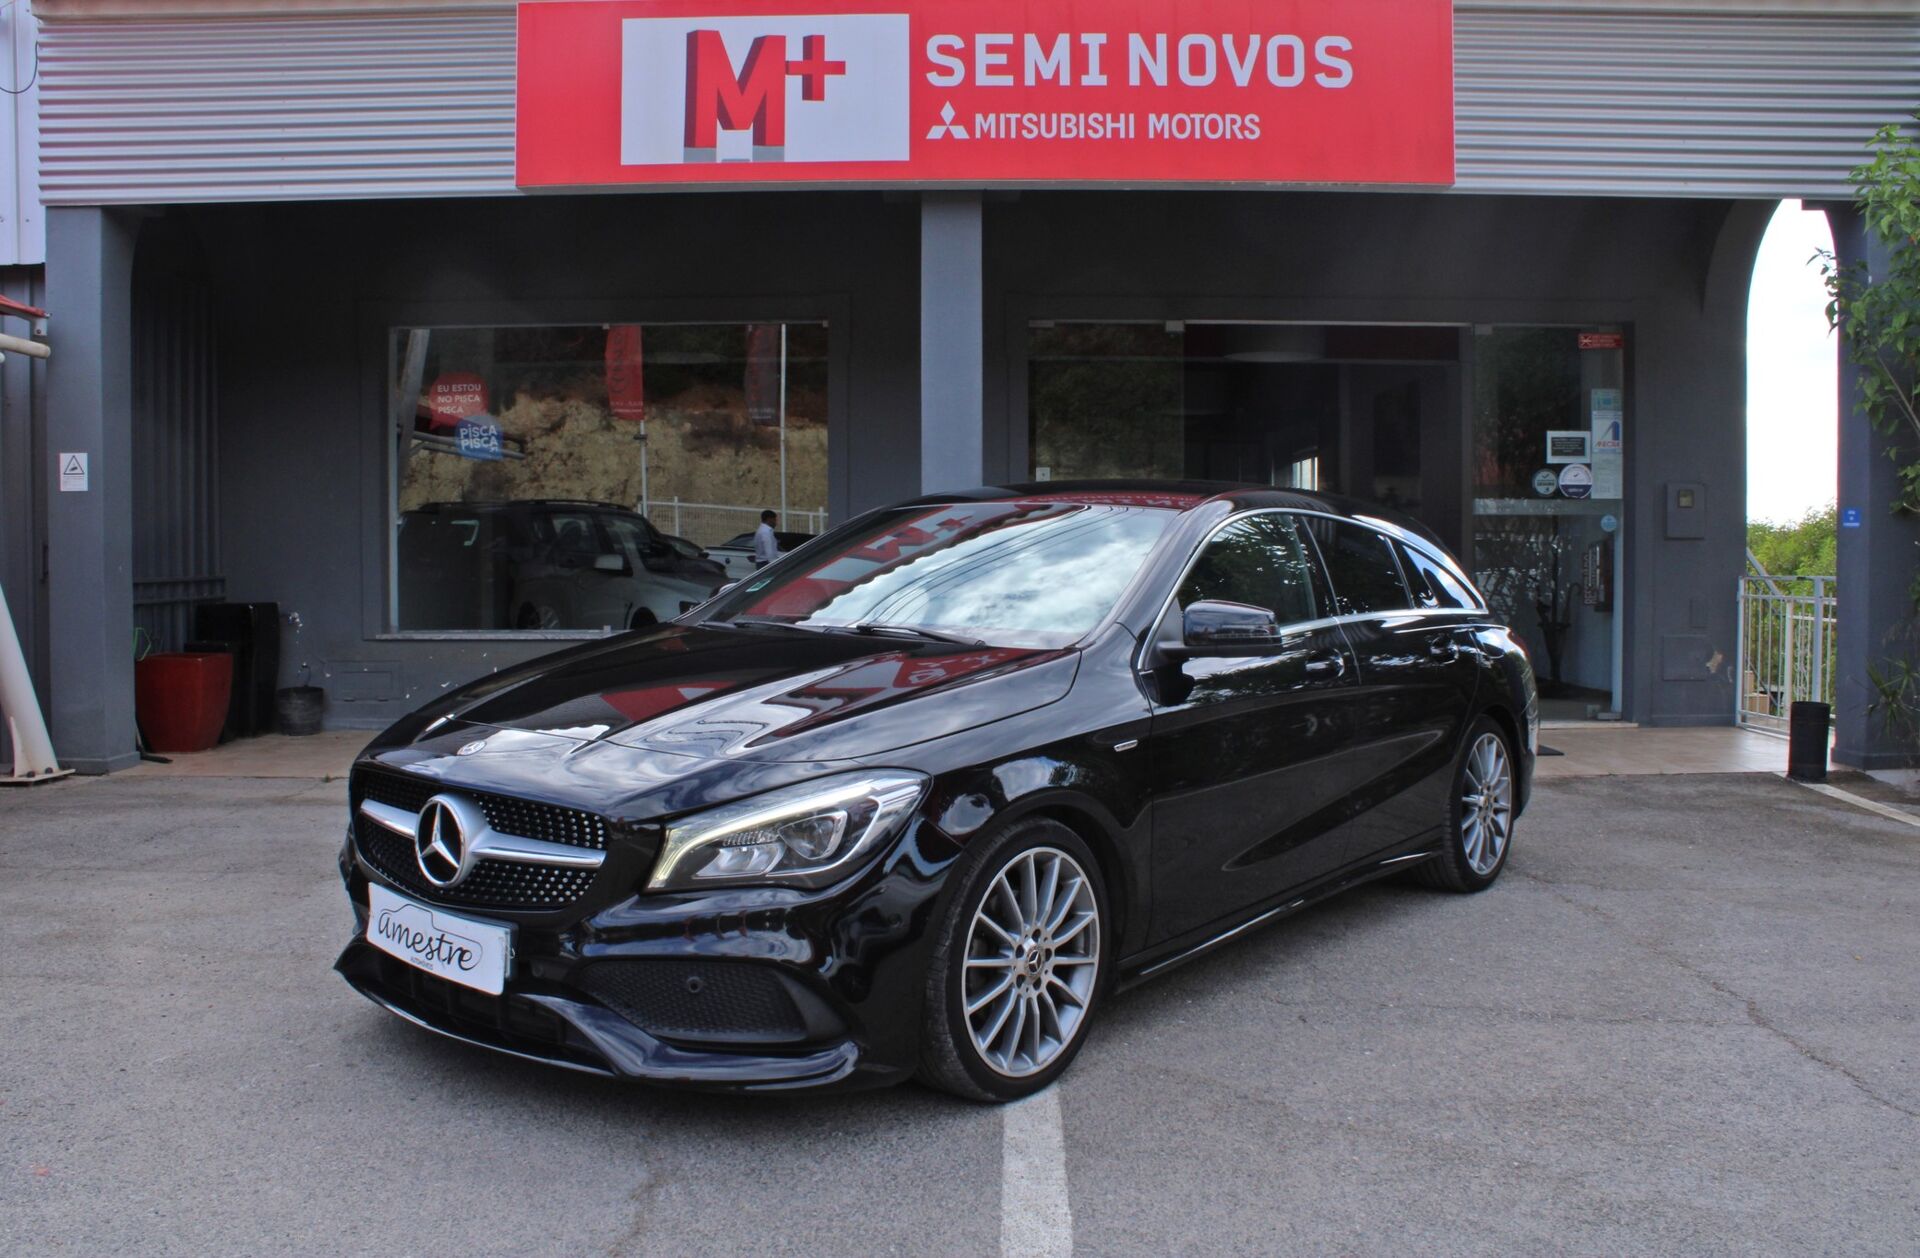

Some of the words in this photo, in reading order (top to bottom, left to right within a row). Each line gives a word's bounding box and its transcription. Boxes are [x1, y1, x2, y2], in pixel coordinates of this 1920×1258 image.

[925, 33, 1107, 87] SEMI
[1128, 33, 1354, 88] NOVOS
[974, 112, 1135, 139] MITSUBISHI
[1148, 112, 1261, 140] MOTORS
[452, 384, 481, 392] ESTOU
[461, 436, 498, 450] PISCA
[378, 912, 474, 972] amestre
